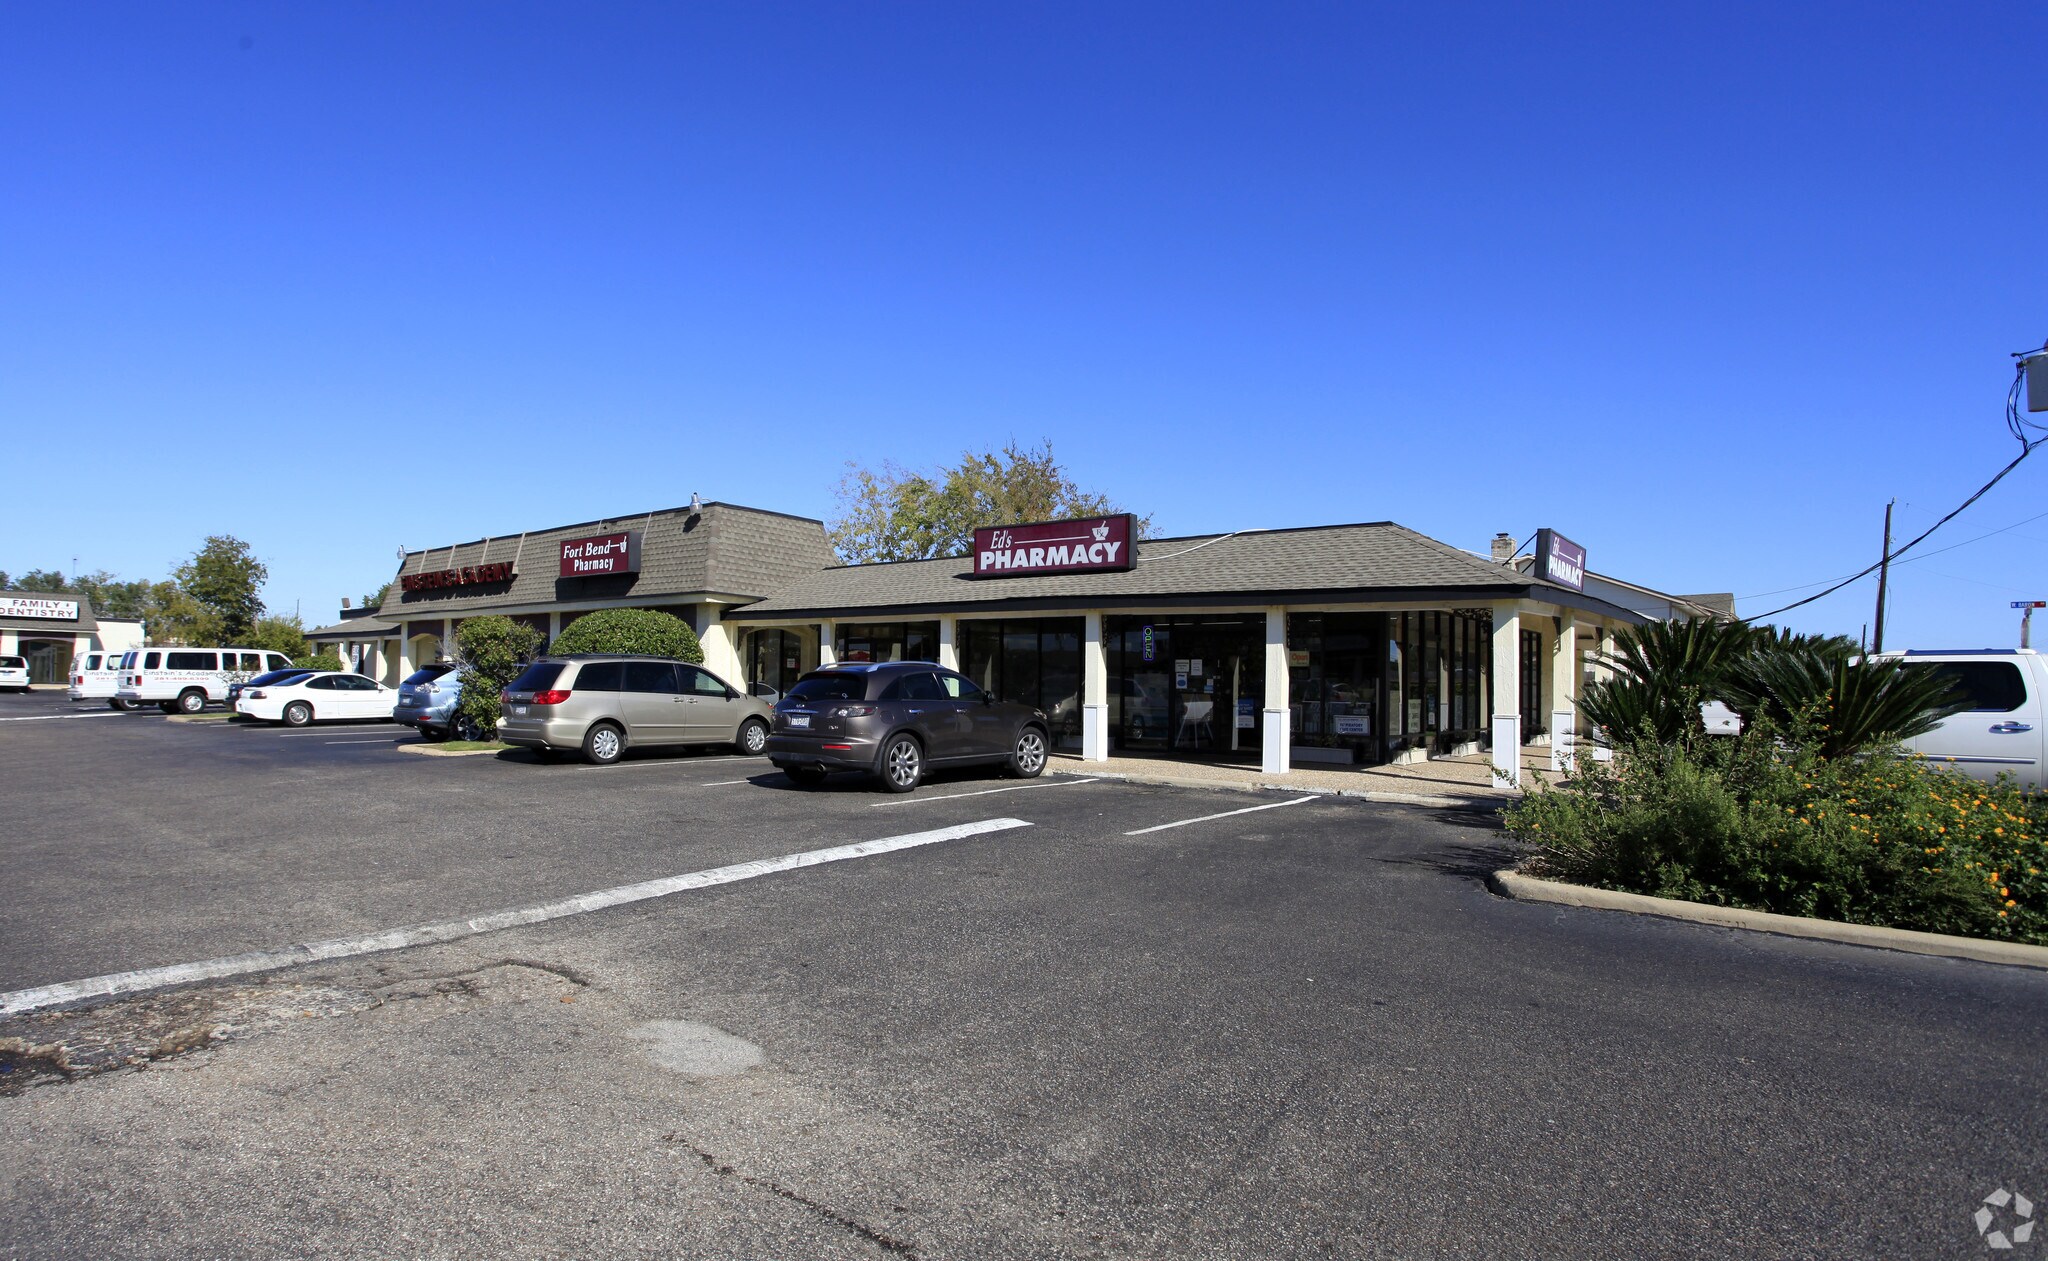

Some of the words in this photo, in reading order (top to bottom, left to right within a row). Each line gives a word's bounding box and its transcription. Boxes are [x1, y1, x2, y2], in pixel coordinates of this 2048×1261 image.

[563, 545, 583, 559] Fort
[585, 539, 611, 556] Bend
[990, 530, 1012, 549] Ed's
[574, 558, 614, 572] Pharmacy
[980, 541, 1122, 570] PHARMACY
[455, 561, 514, 585] ACADEMY
[1548, 555, 1583, 587] PHARMACY
[0, 607, 74, 618] DENTISTRY
[13, 599, 61, 608] FAMILY
[1144, 627, 1153, 659] OPEN
